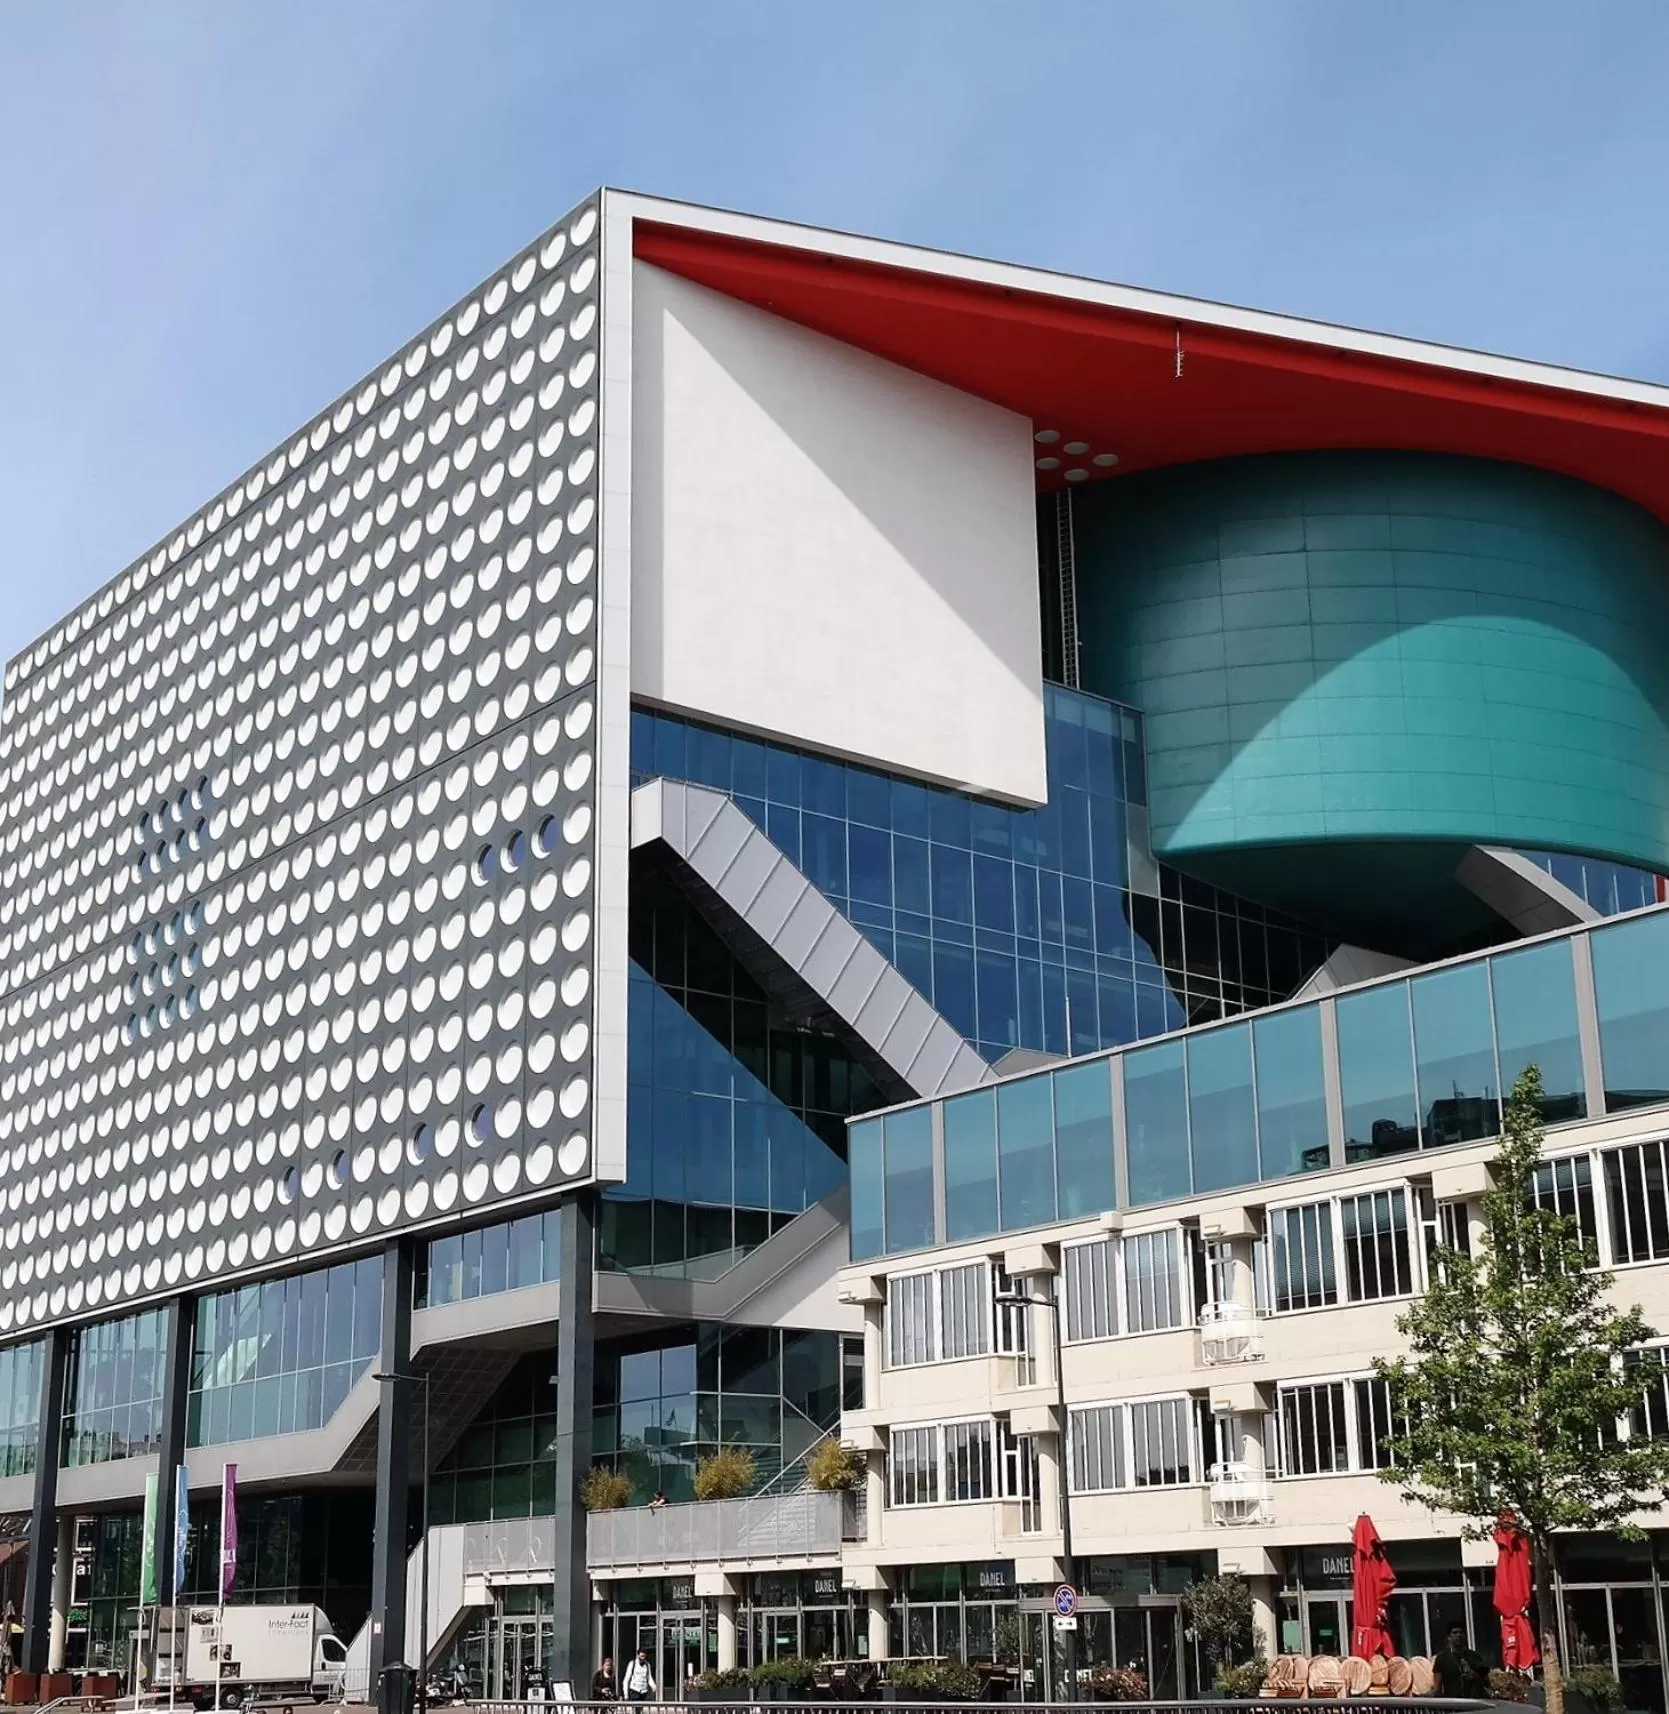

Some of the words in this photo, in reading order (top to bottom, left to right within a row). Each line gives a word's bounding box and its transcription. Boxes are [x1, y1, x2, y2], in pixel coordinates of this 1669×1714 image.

[1322, 1556, 1355, 1575] DANEL
[814, 1579, 837, 1593] DANEL
[980, 1572, 1006, 1587] DANEL
